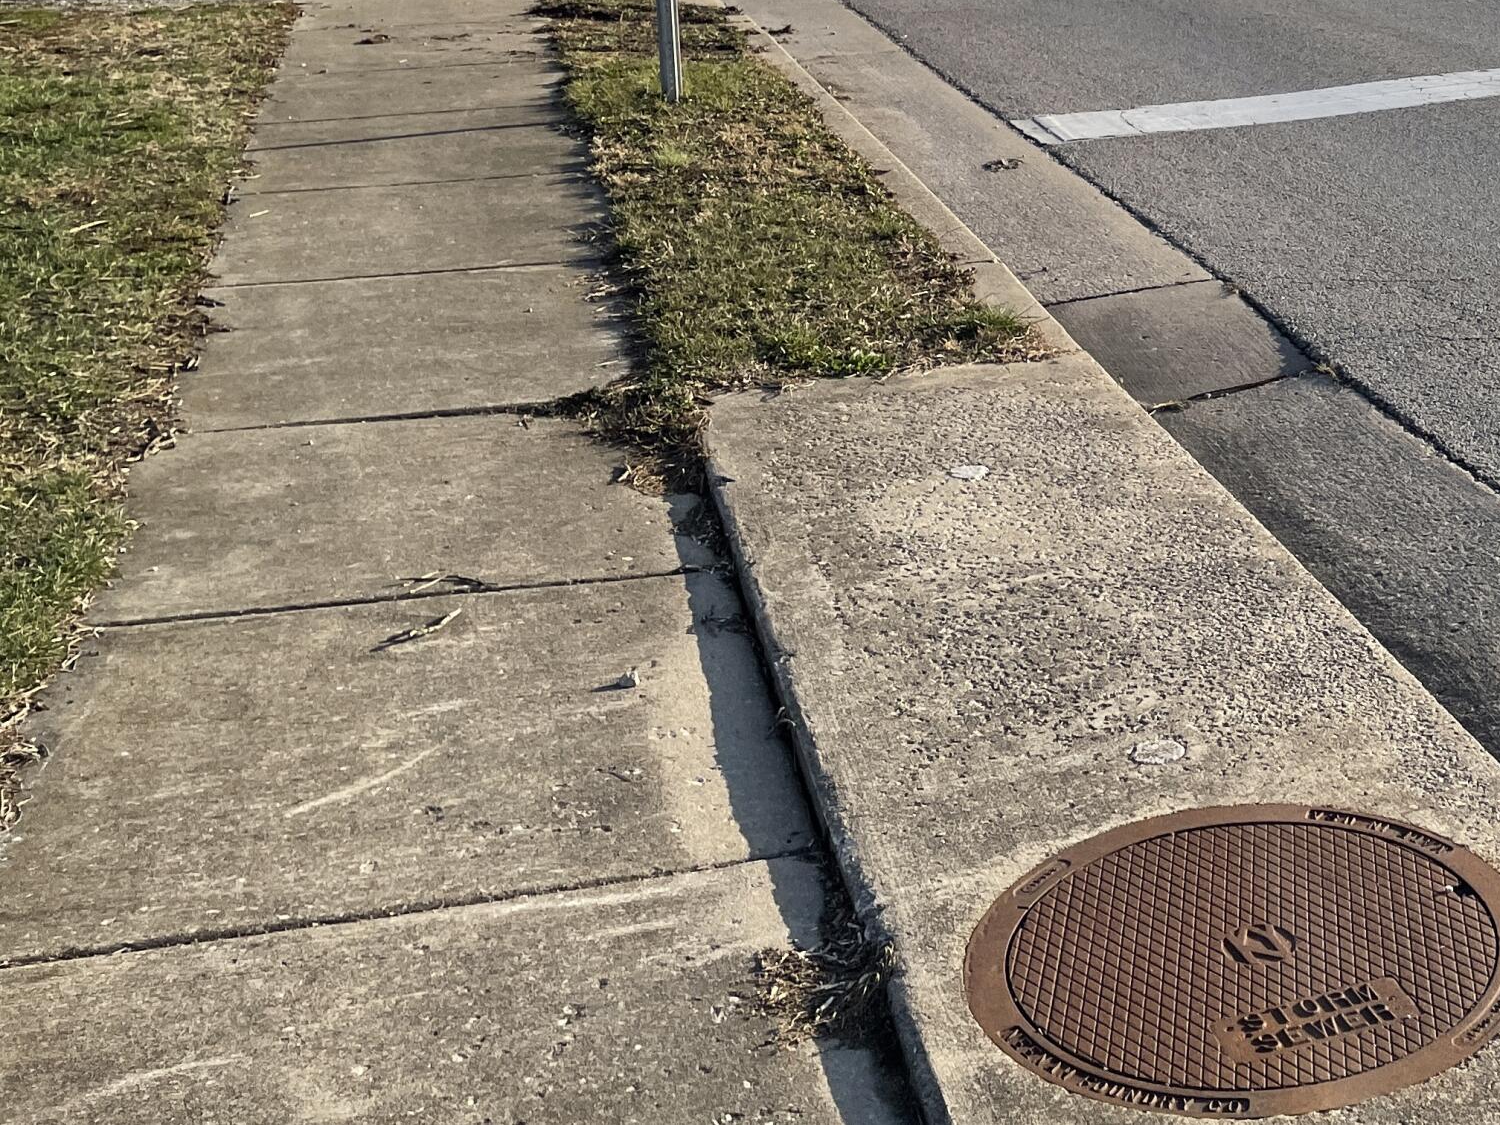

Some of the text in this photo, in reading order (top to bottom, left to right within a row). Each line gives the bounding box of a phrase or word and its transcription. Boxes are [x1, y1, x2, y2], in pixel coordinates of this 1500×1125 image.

[1236, 983, 1379, 1032] STORM
[1250, 1003, 1397, 1054] SEWER
[1078, 1075, 1196, 1111] FOUNDRY
